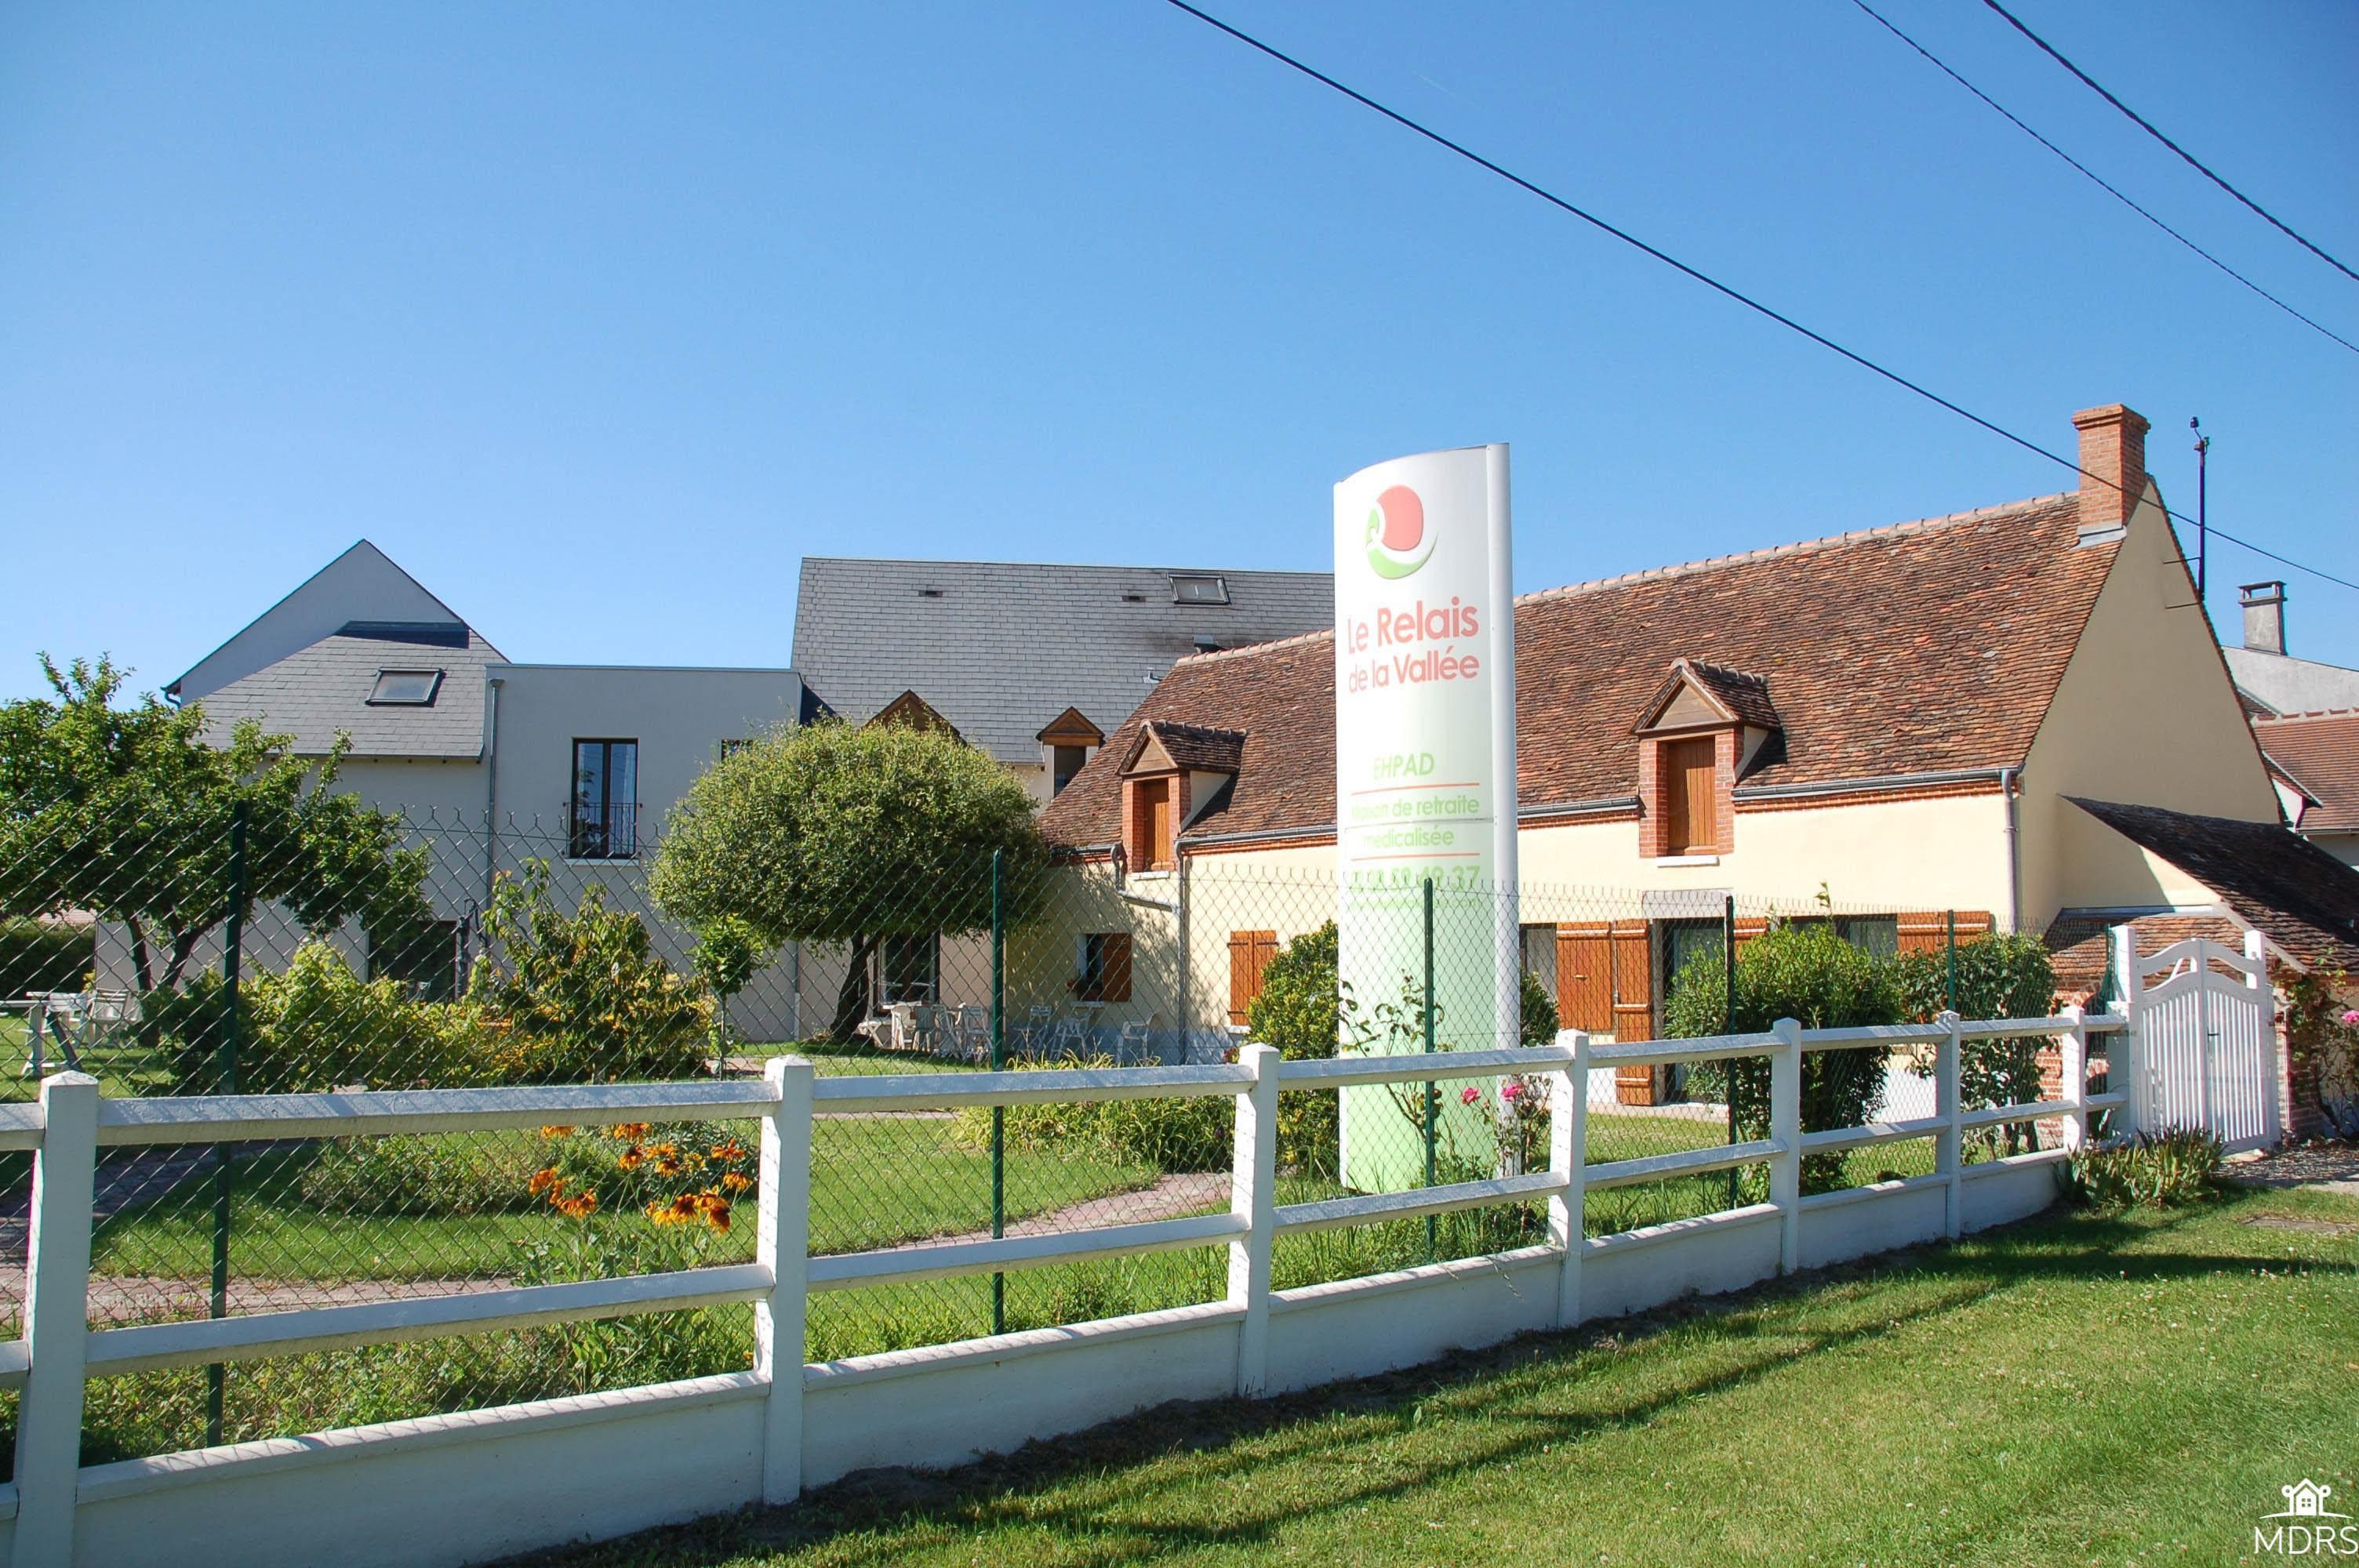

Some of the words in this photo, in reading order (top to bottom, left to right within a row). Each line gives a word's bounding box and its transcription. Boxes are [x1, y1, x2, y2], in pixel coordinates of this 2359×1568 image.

[1348, 616, 1369, 654] Le
[1377, 596, 1479, 647] Relais
[1349, 664, 1368, 693] de
[1372, 659, 1390, 688] la
[1393, 645, 1480, 684] Vallée
[1373, 752, 1435, 780] EHPAD
[1392, 798, 1412, 817] de
[1416, 794, 1480, 816] retraite
[1452, 865, 1481, 891] 37
